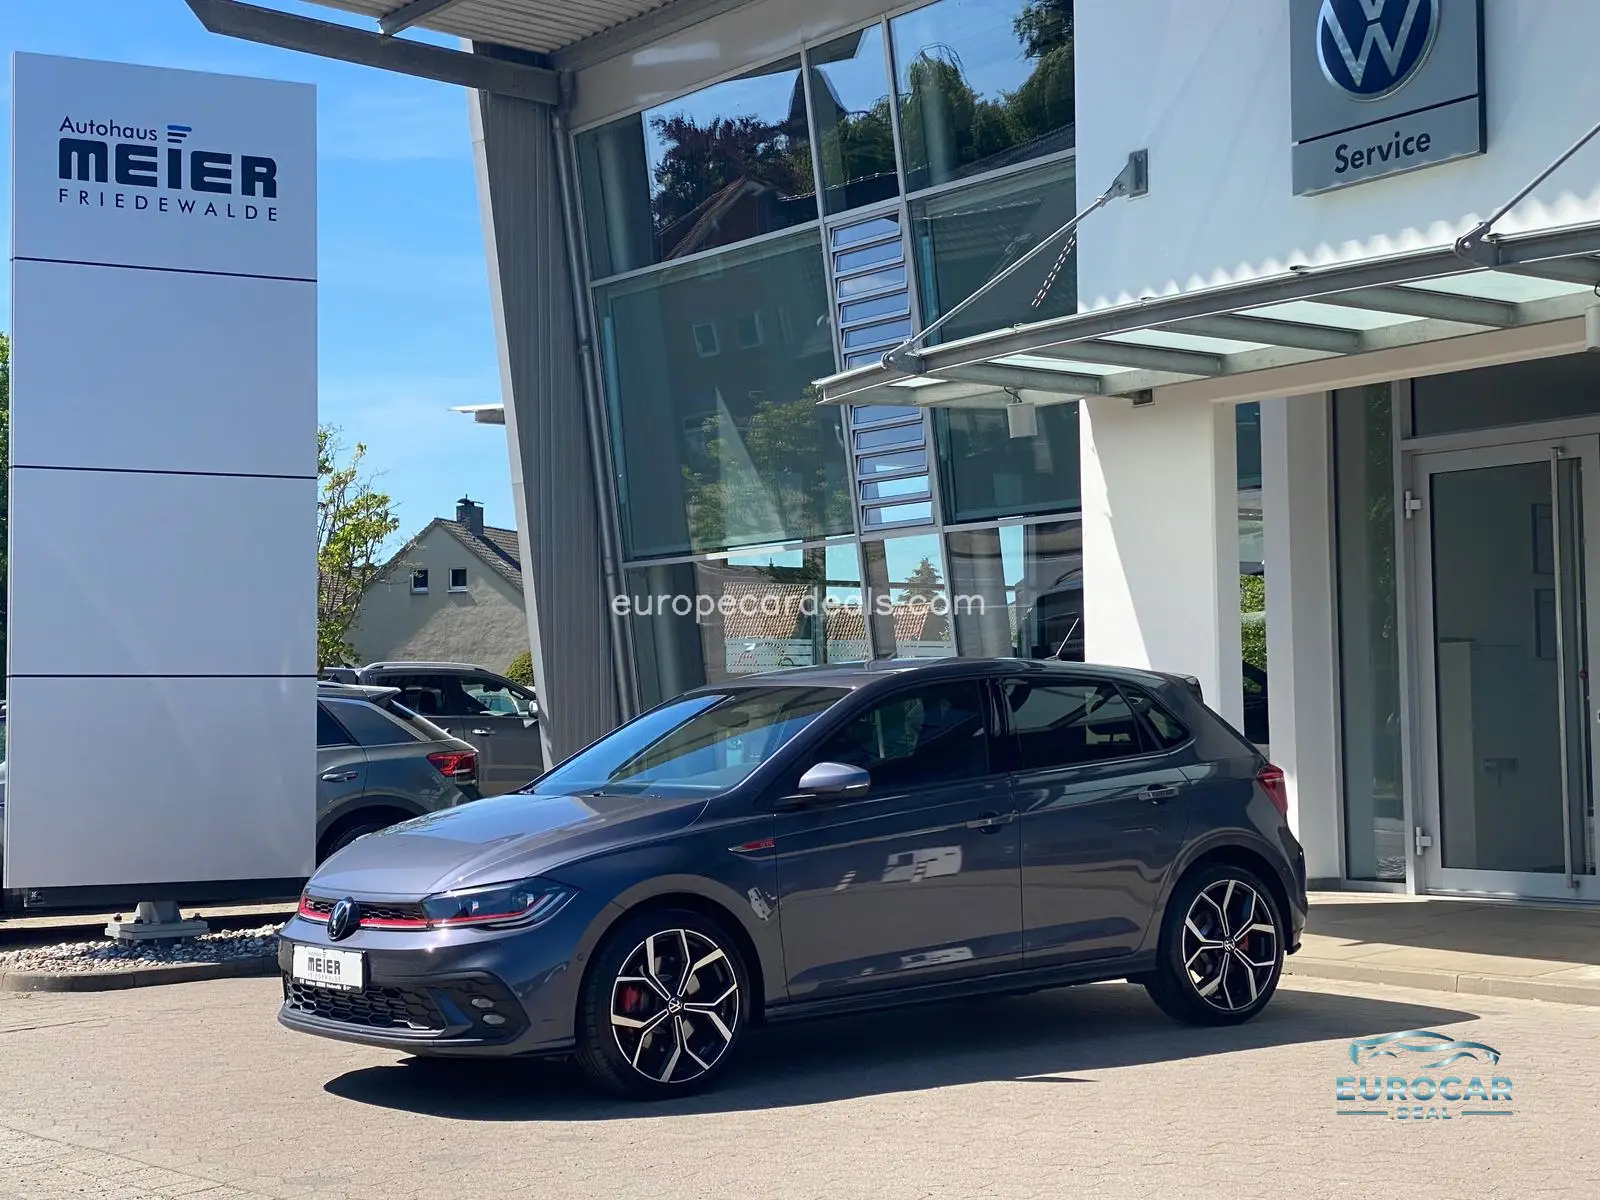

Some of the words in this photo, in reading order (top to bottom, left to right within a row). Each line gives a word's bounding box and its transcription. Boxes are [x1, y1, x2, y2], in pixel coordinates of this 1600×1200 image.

[59, 115, 158, 141] Autohaus
[58, 125, 277, 199] MEIER
[1334, 131, 1431, 173] Service
[59, 188, 277, 222] FRIEDEWALDE
[308, 956, 341, 975] MEIER
